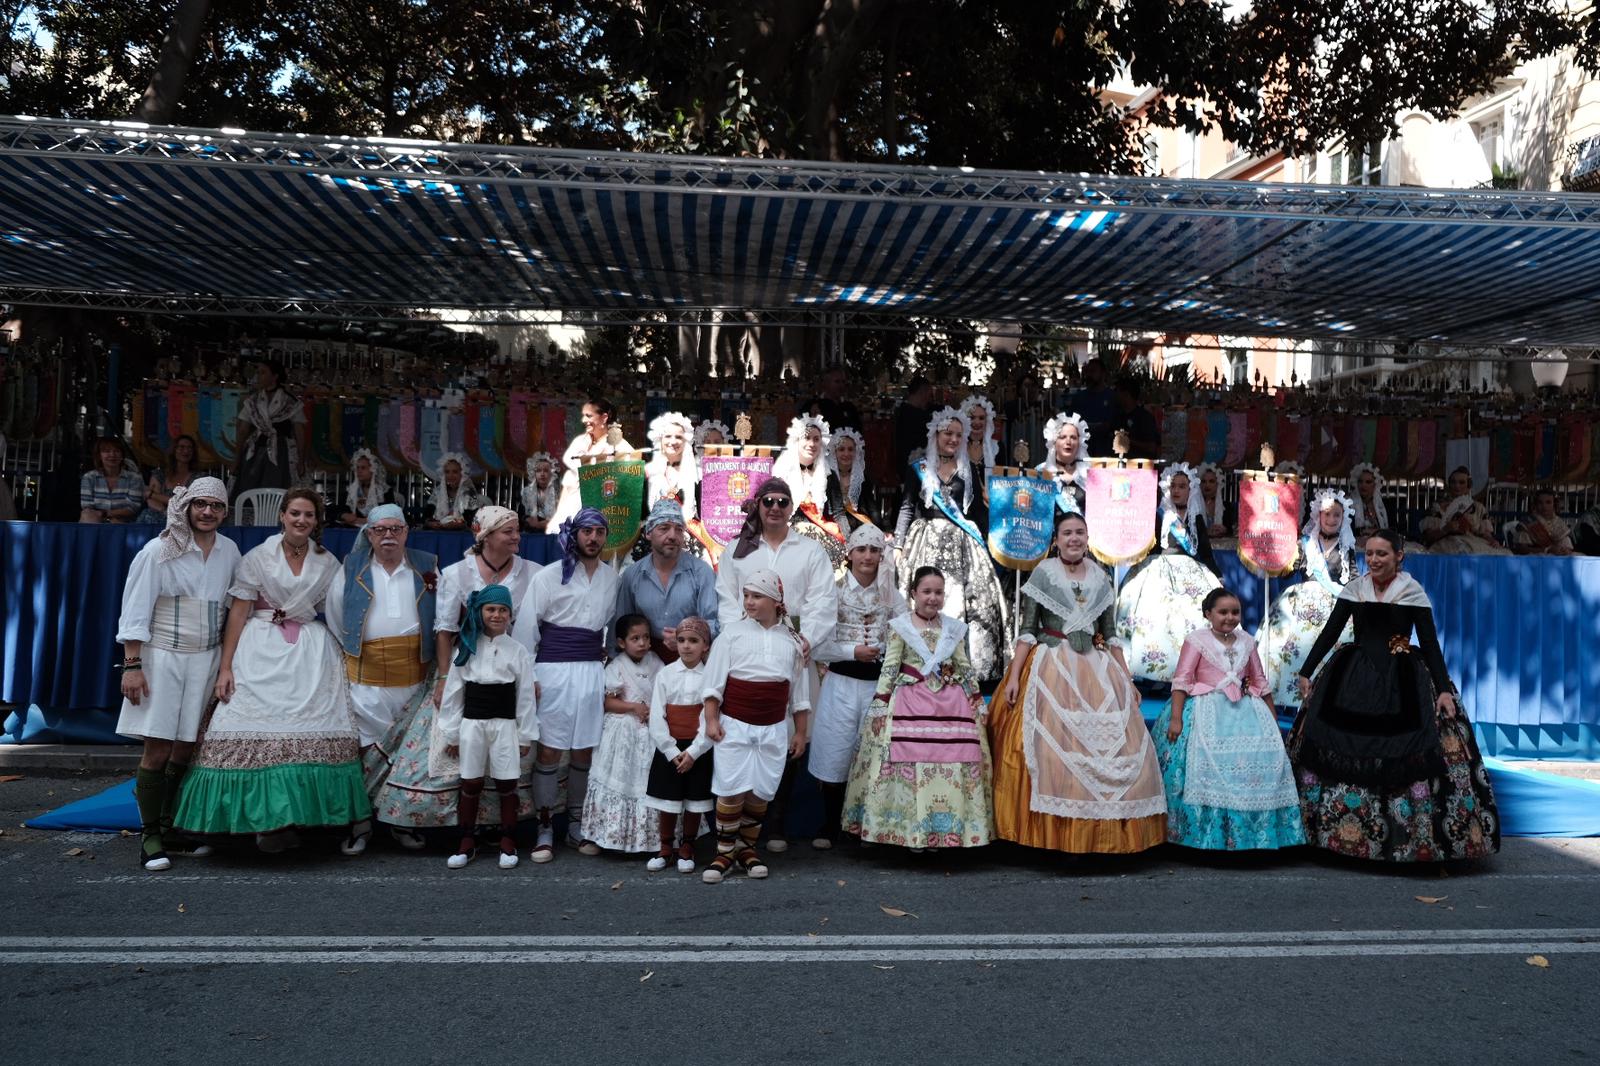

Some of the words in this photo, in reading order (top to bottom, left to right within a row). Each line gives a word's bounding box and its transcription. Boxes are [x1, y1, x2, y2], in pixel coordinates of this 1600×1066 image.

[1104, 508, 1137, 519] PREMI
[1012, 517, 1042, 530] PREMI
[1256, 520, 1283, 531] PREMI
